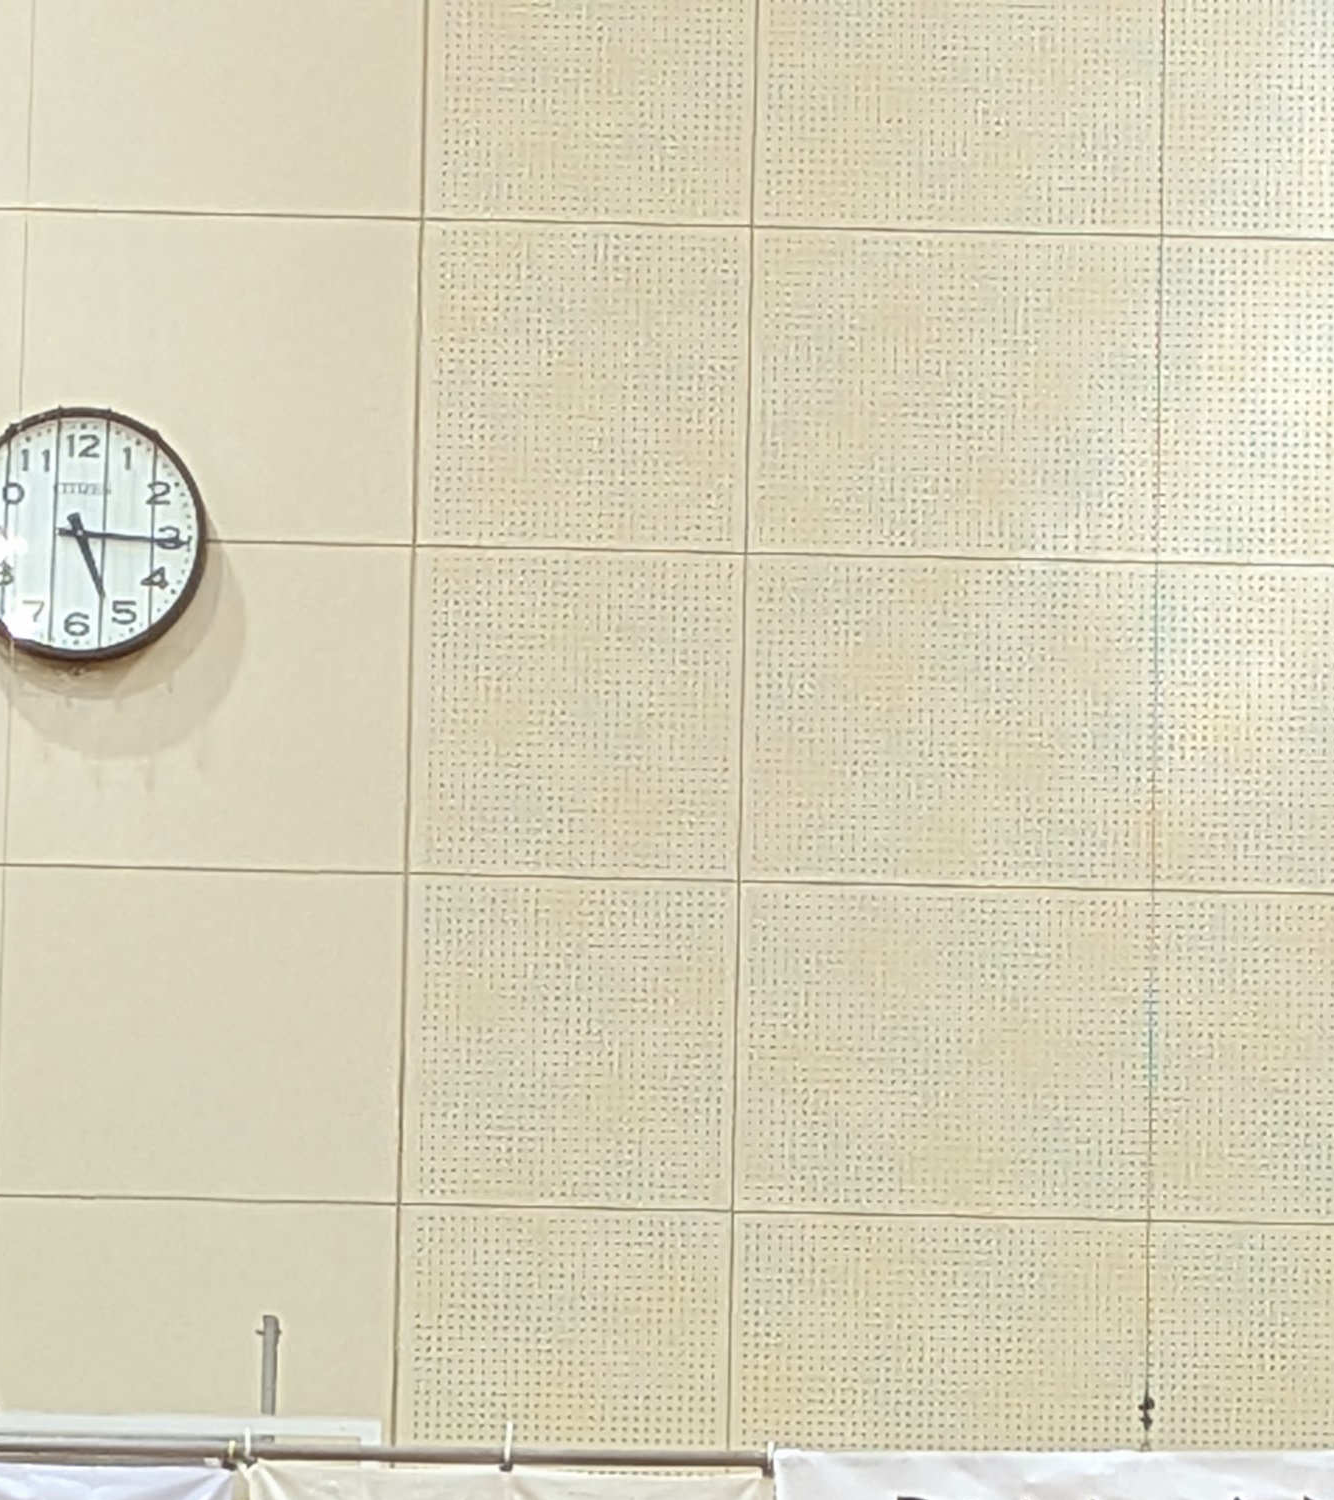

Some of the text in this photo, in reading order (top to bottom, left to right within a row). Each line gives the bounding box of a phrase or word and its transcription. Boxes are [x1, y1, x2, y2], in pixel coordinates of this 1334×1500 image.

[66, 433, 101, 459] 12
[122, 446, 132, 471] 1
[20, 448, 51, 473] 11
[145, 480, 172, 506] 2
[156, 525, 181, 550] 3
[140, 566, 168, 590] 4
[21, 599, 45, 623] 7
[111, 599, 137, 625] 5
[62, 611, 90, 637] 6
